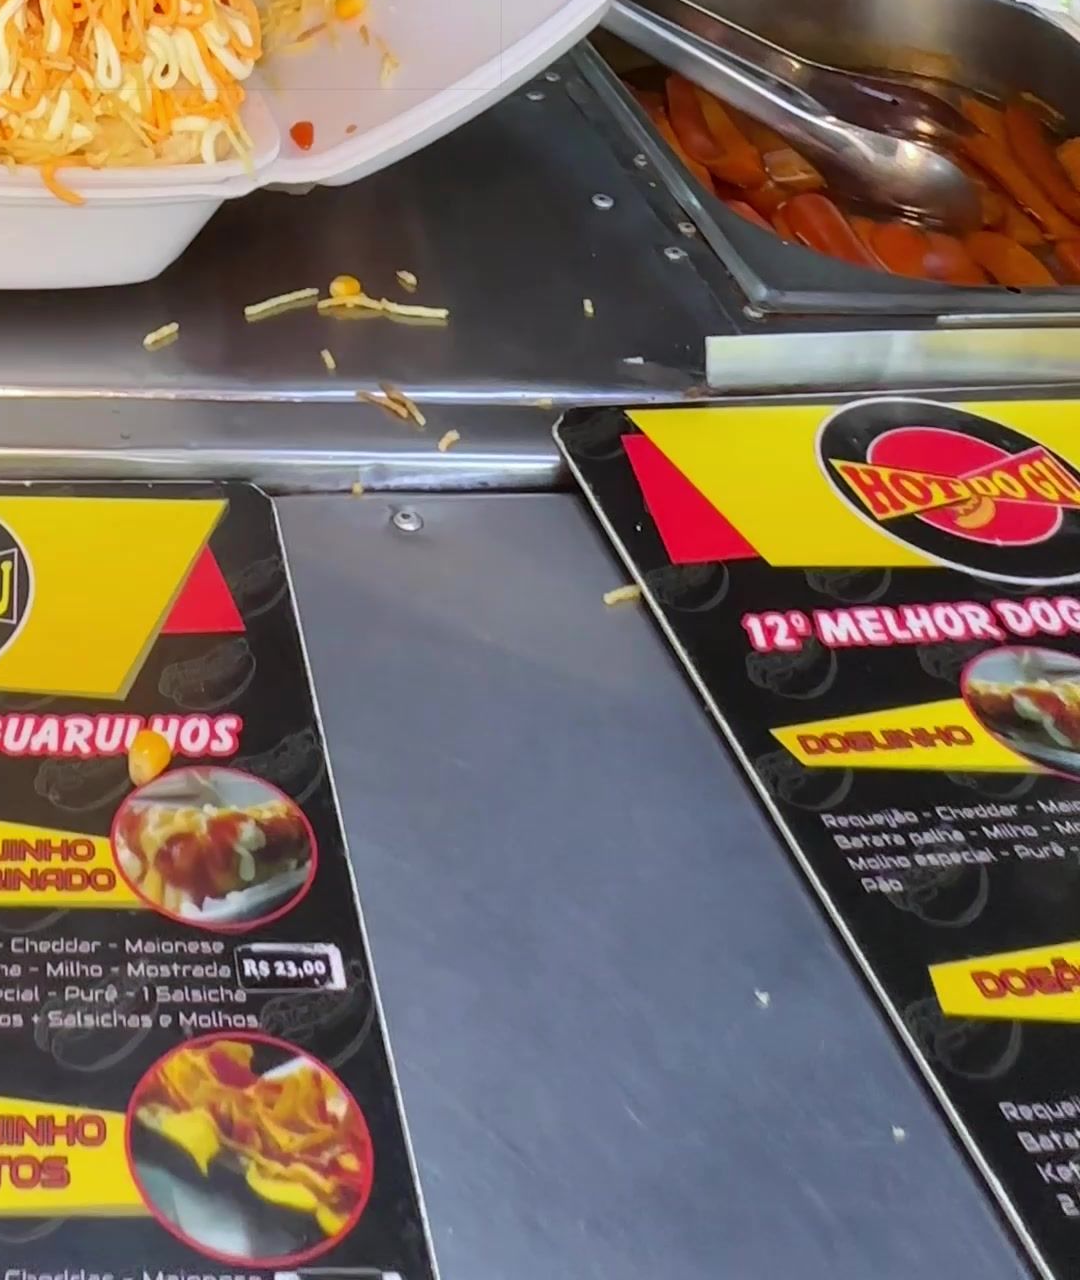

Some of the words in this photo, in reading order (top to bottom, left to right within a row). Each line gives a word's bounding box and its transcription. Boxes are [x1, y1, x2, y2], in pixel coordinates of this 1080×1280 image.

[816, 603, 1003, 646] MELHOR
[797, 726, 975, 755] DOGUINHO
[935, 803, 1019, 821] Cheddar
[834, 831, 906, 850] Batata
[909, 828, 966, 846] palha
[981, 822, 1038, 839] Milho
[848, 855, 911, 871] Molho
[915, 847, 998, 867] especial
[11, 937, 101, 954] Cheddar
[125, 938, 225, 954] Maionese
[46, 960, 103, 978] Milho
[127, 961, 232, 979] Mostrada
[242, 958, 270, 980] R$
[274, 960, 327, 978] 23,00
[64, 983, 118, 1003] Purê
[155, 985, 247, 1003] Salsicha
[47, 1010, 153, 1029] Salsichas
[160, 1014, 173, 1028] e
